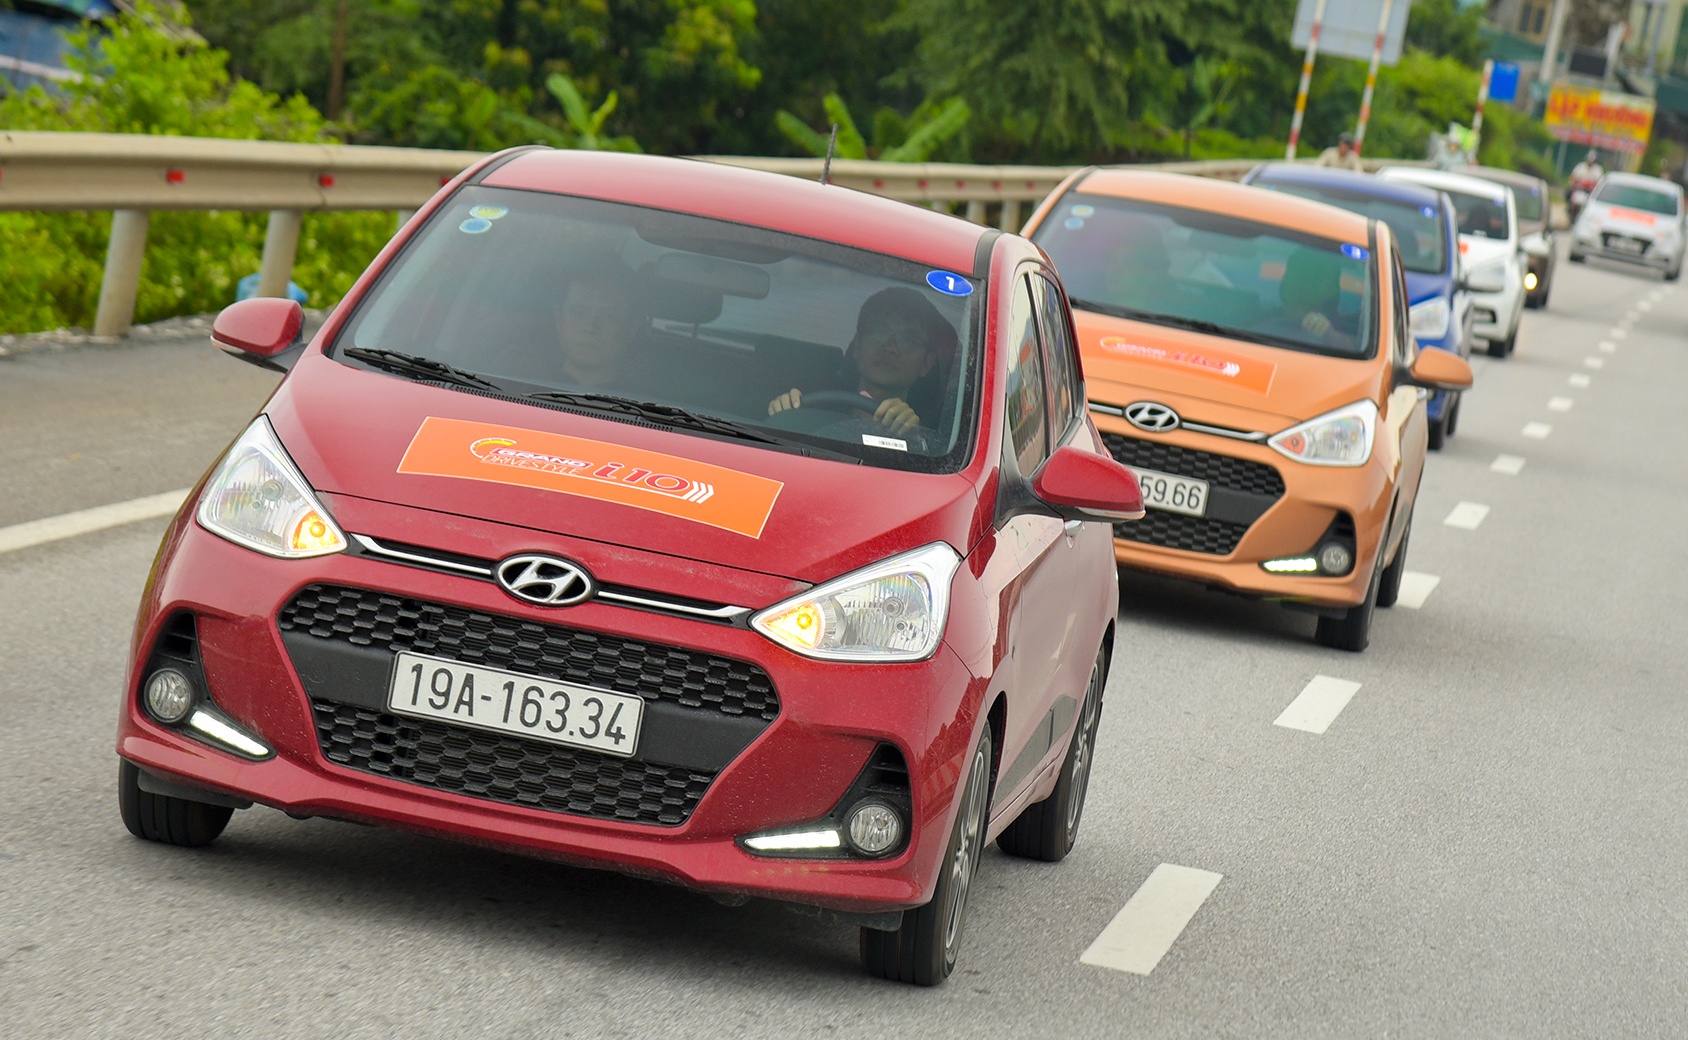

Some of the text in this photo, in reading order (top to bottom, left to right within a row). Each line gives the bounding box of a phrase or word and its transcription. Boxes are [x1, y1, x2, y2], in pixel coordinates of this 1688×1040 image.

[945, 276, 955, 291] 1
[482, 454, 584, 475] DRIVESTYLE
[497, 448, 588, 468] GRAND
[411, 663, 626, 745] 19A-163.34
